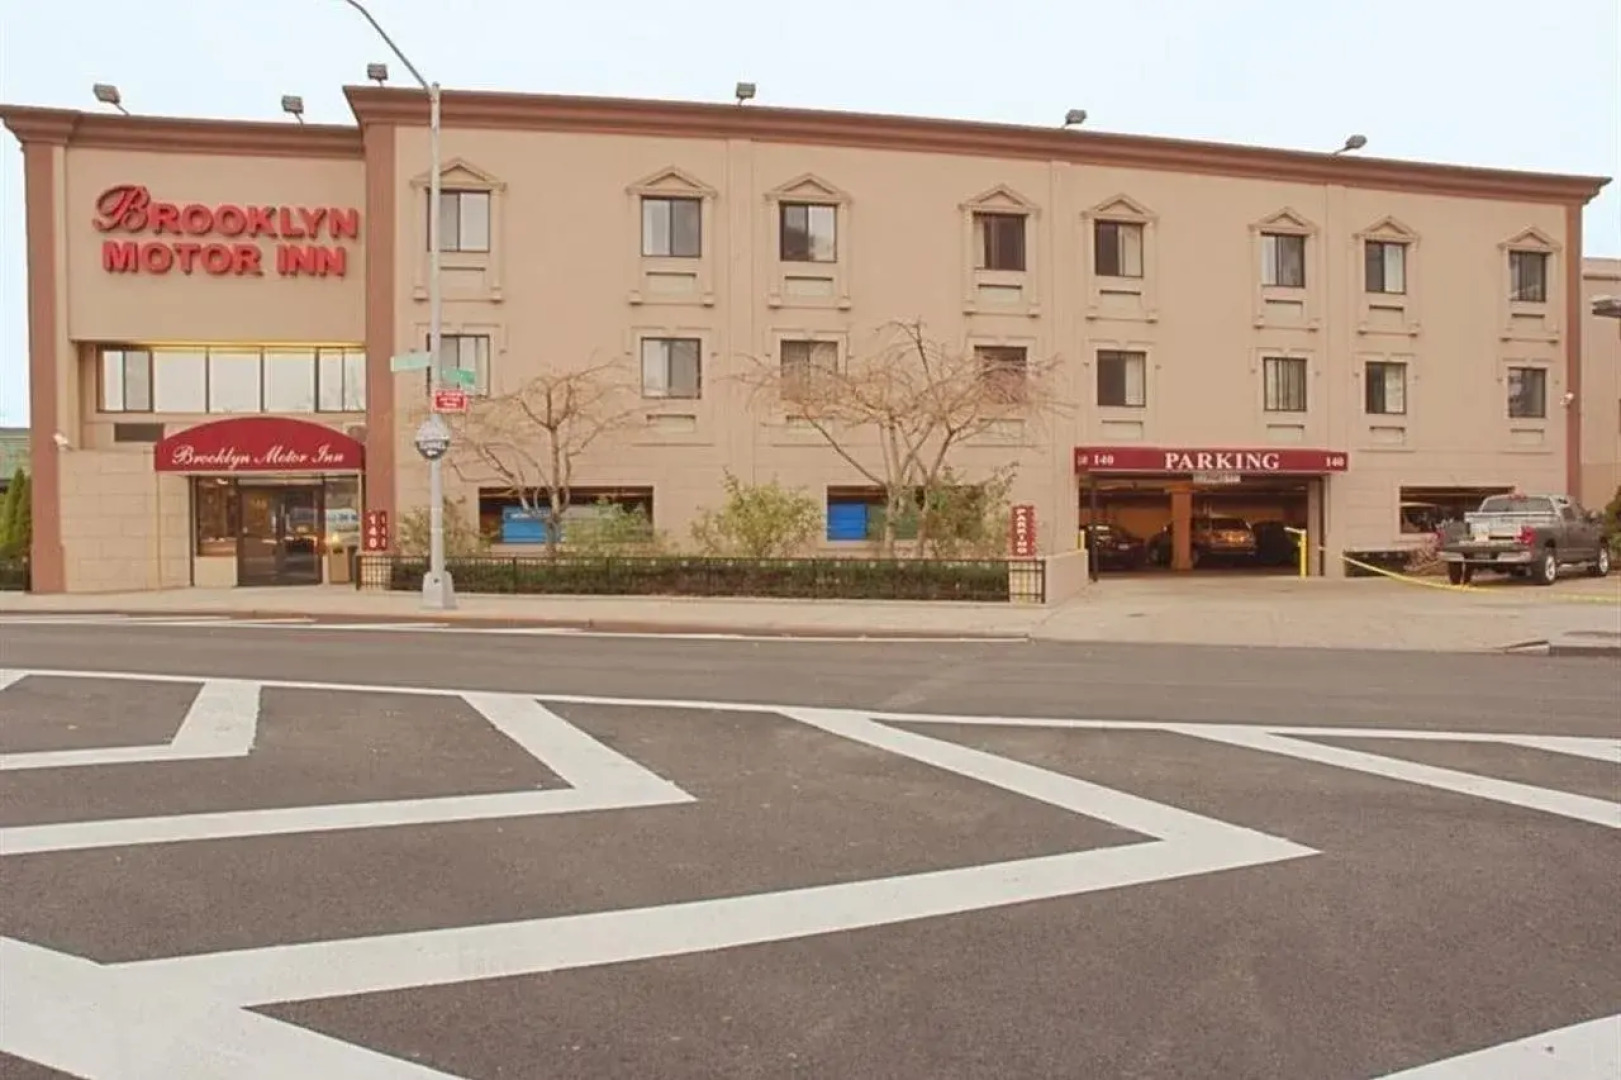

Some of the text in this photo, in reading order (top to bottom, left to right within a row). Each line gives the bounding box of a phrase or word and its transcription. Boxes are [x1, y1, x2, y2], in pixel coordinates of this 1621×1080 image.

[92, 184, 359, 240] BROOKLYN
[102, 240, 347, 277] MOTOR INN
[171, 444, 345, 470] Brooklyn Motor Inn
[1093, 454, 1115, 466] 140
[1164, 451, 1281, 470] PARKING
[1325, 456, 1345, 468] 140
